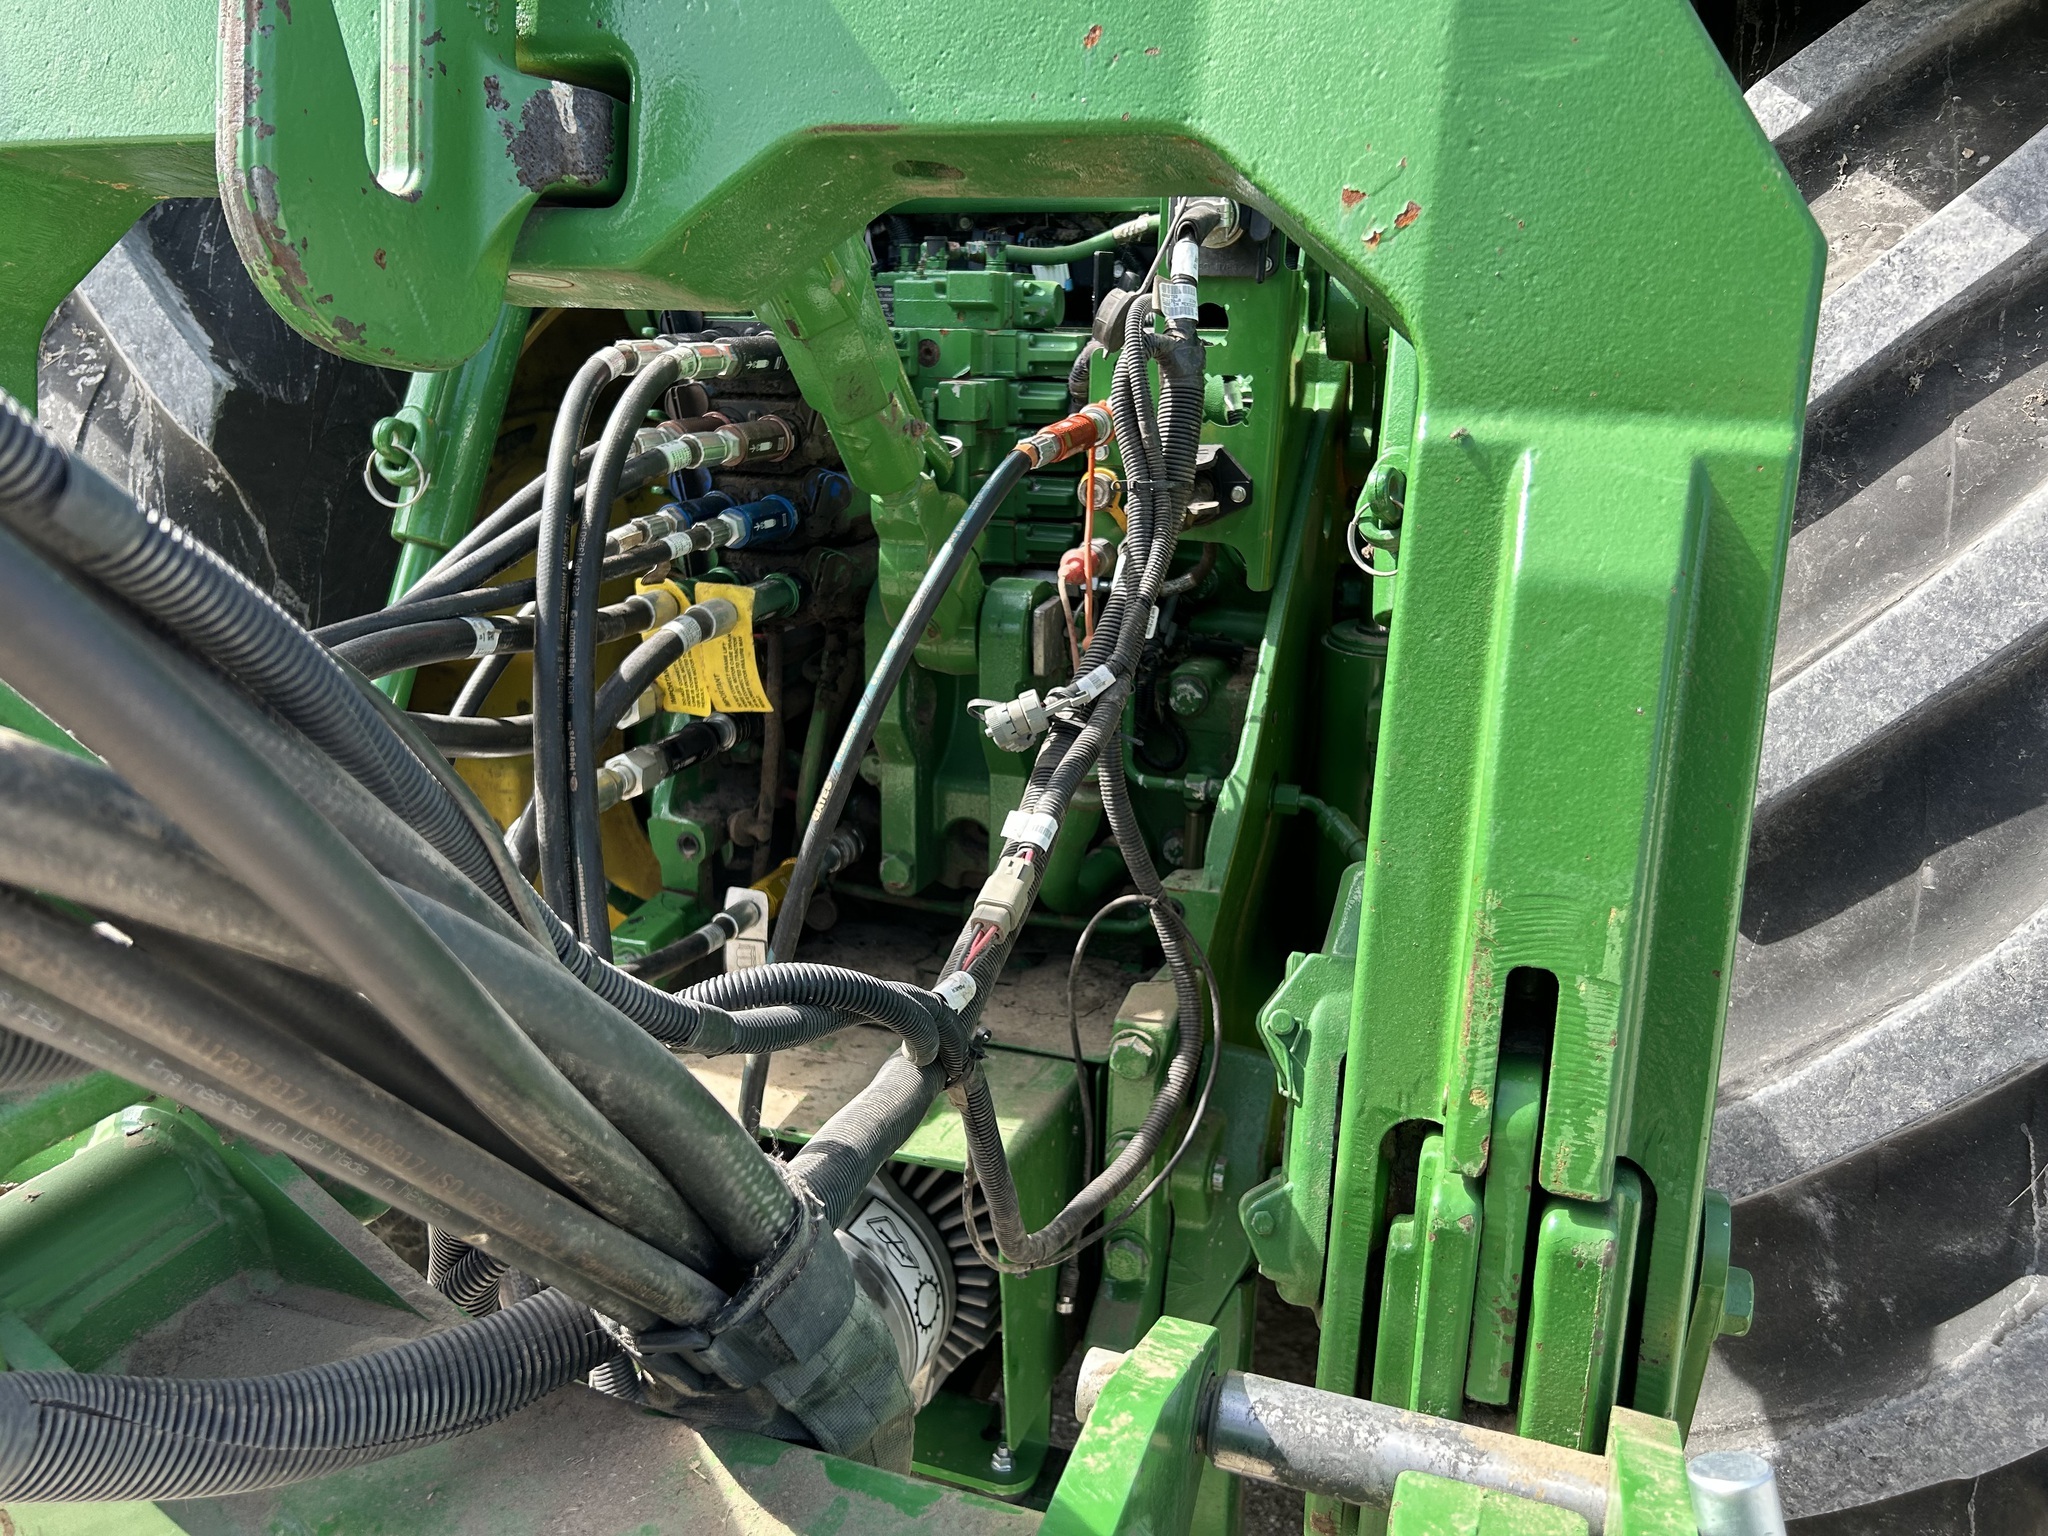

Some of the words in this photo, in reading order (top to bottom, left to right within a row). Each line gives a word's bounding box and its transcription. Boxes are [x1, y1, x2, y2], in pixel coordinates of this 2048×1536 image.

[576, 531, 587, 555] (3250
[713, 673, 731, 707] IMPORTANT
[737, 669, 748, 696] CONNECTED
[812, 780, 833, 822] GATES
[146, 1058, 260, 1120] Engineered
[264, 1119, 287, 1136] in
[292, 1128, 326, 1154] USA
[329, 1148, 370, 1176] Made
[375, 1176, 396, 1190] in
[398, 1184, 450, 1218] Mexico
[265, 1074, 308, 1106] R17
[357, 1127, 426, 1170] 100R17
[617, 1272, 668, 1304] Resistant
